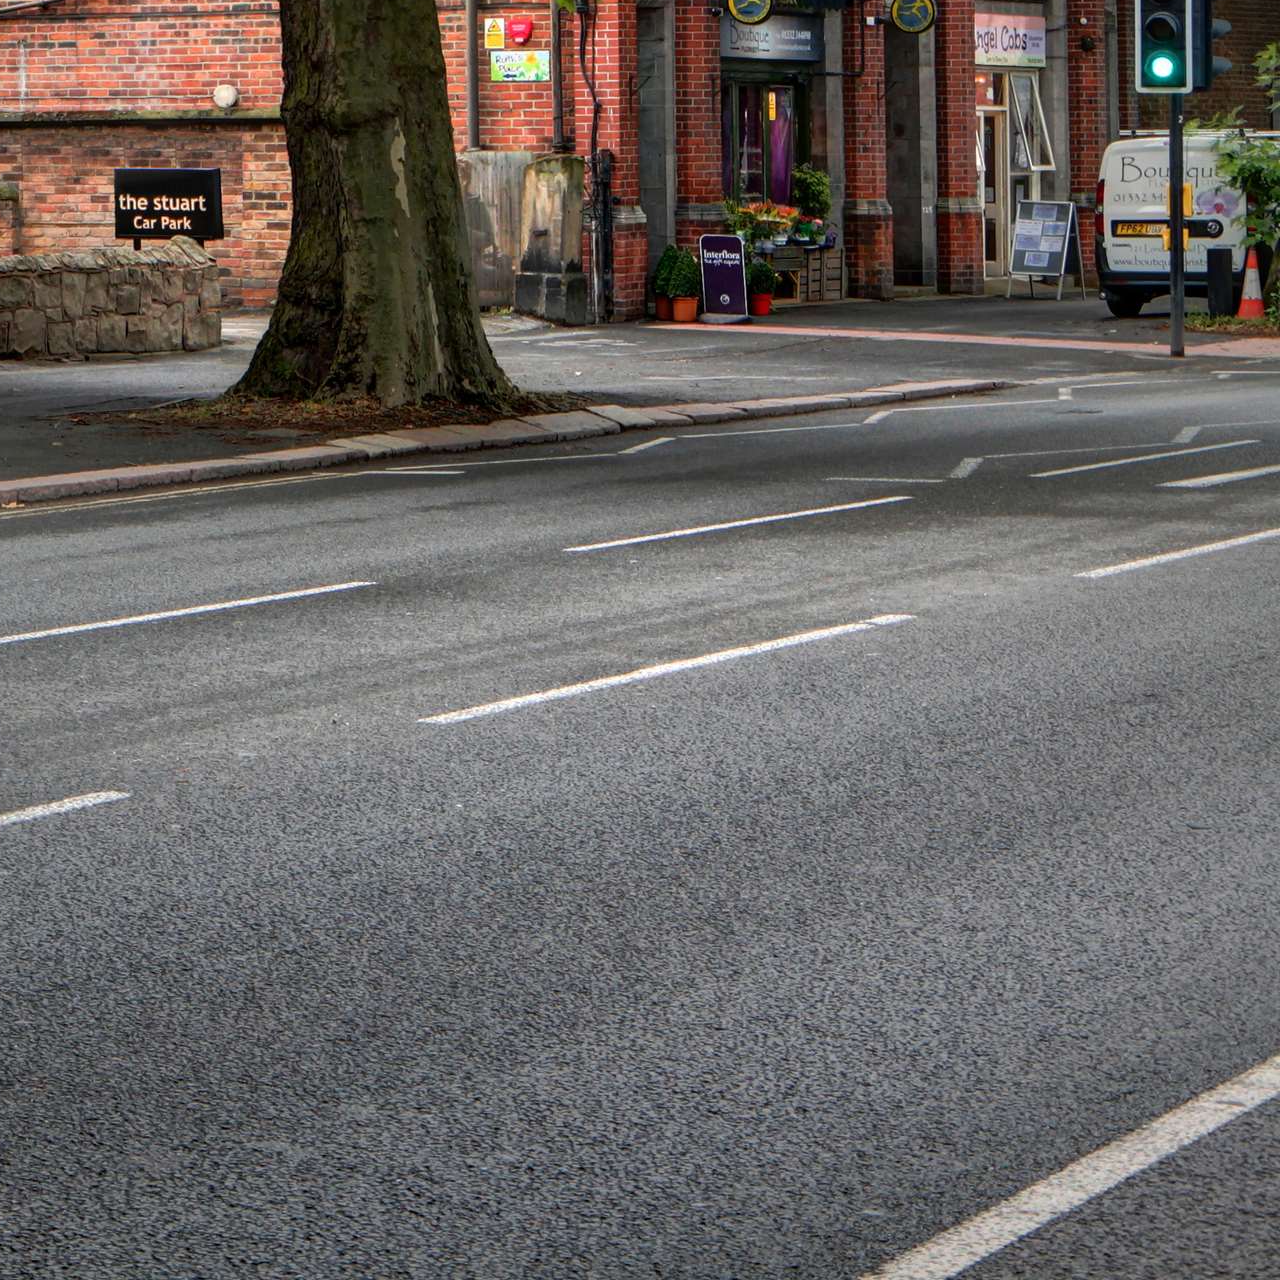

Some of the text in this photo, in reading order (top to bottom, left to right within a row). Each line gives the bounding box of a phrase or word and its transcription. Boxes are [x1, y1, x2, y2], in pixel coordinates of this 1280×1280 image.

[975, 27, 998, 54] ngel
[1001, 25, 1028, 52] Cobs
[118, 194, 207, 212] the stuart
[133, 216, 192, 230] Car Park
[703, 249, 740, 260] Interflora
